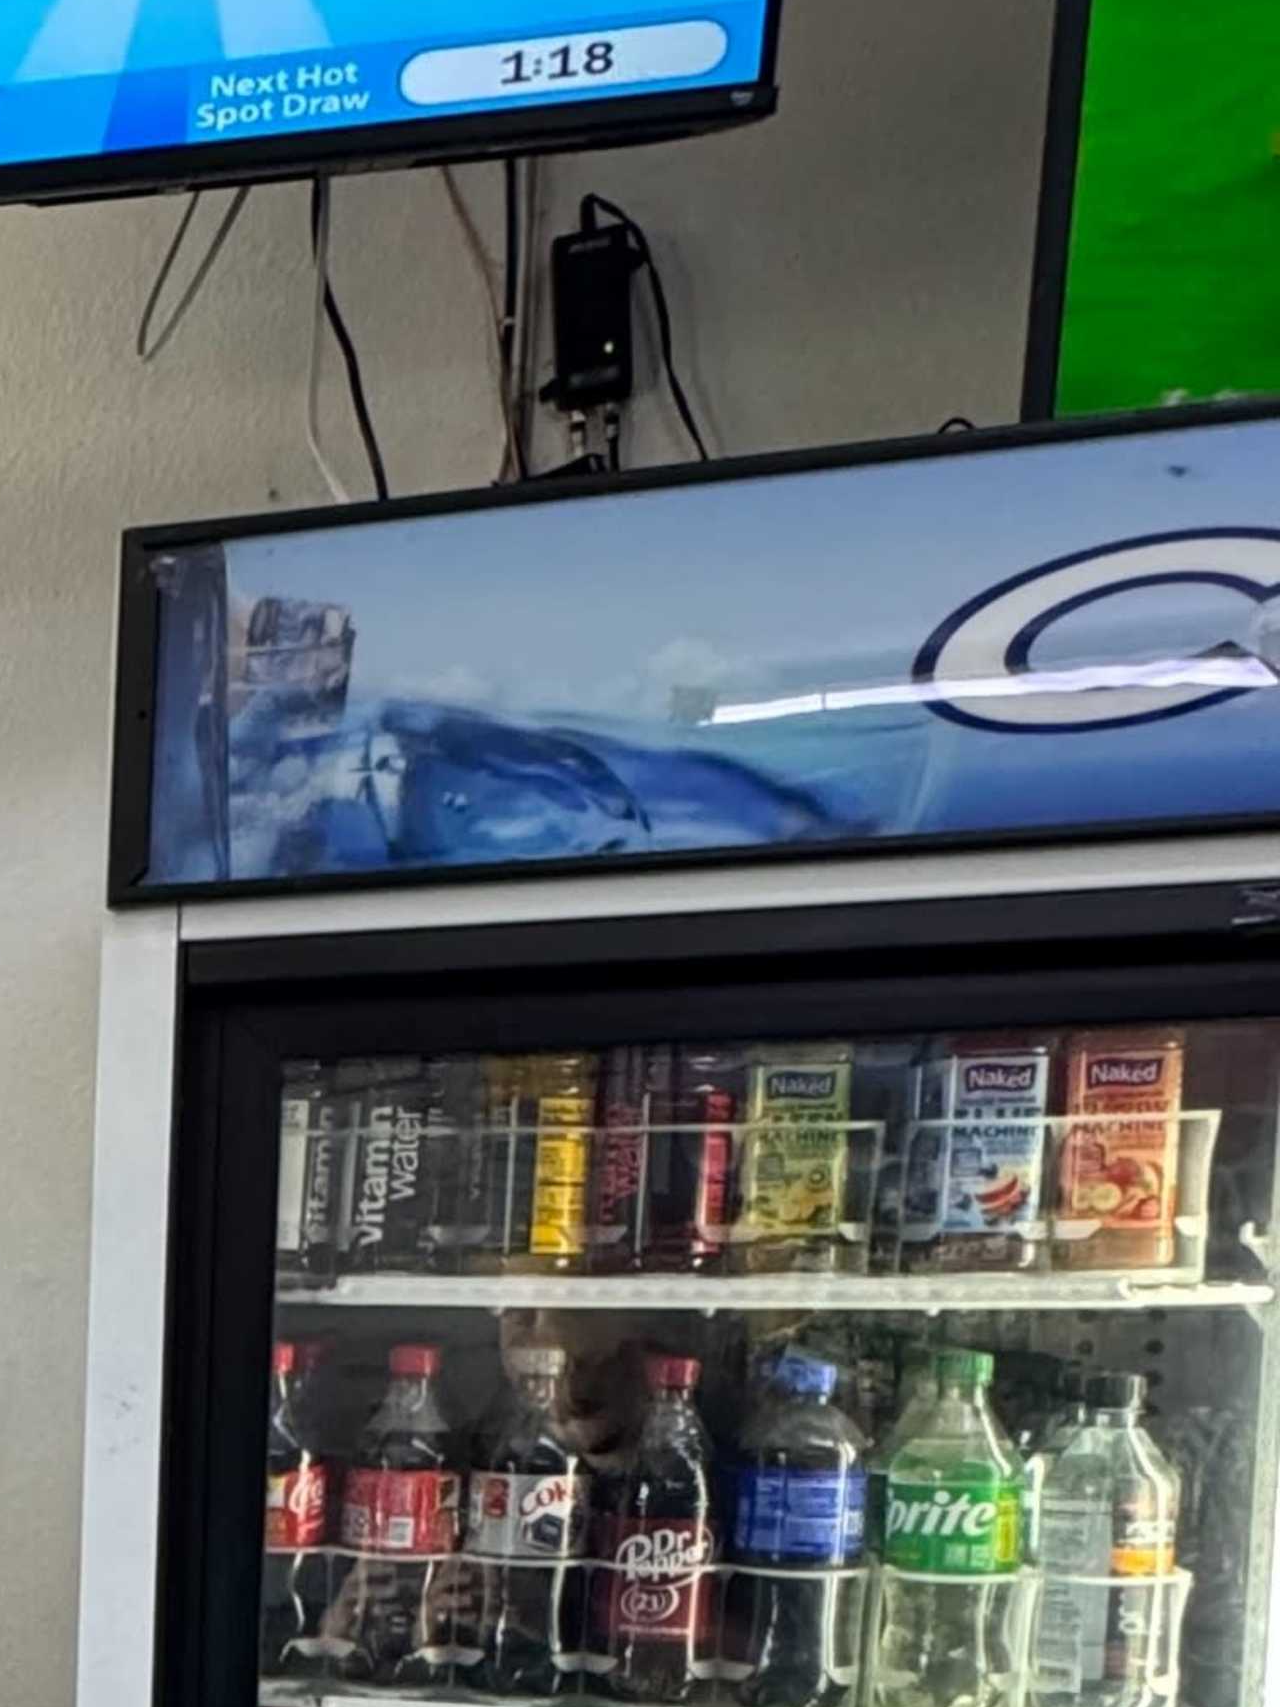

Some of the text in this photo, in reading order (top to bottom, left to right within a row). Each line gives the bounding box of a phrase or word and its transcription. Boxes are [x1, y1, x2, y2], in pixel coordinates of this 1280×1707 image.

[211, 41, 614, 97] Next Hot 1:18
[196, 93, 370, 132] Spot Draw
[770, 1074, 833, 1097] Naked
[967, 1067, 1033, 1090] Naked
[1090, 1062, 1161, 1084] Naked
[389, 1105, 424, 1202] water
[887, 1490, 998, 1541] prite
[653, 1529, 690, 1555] Dr
